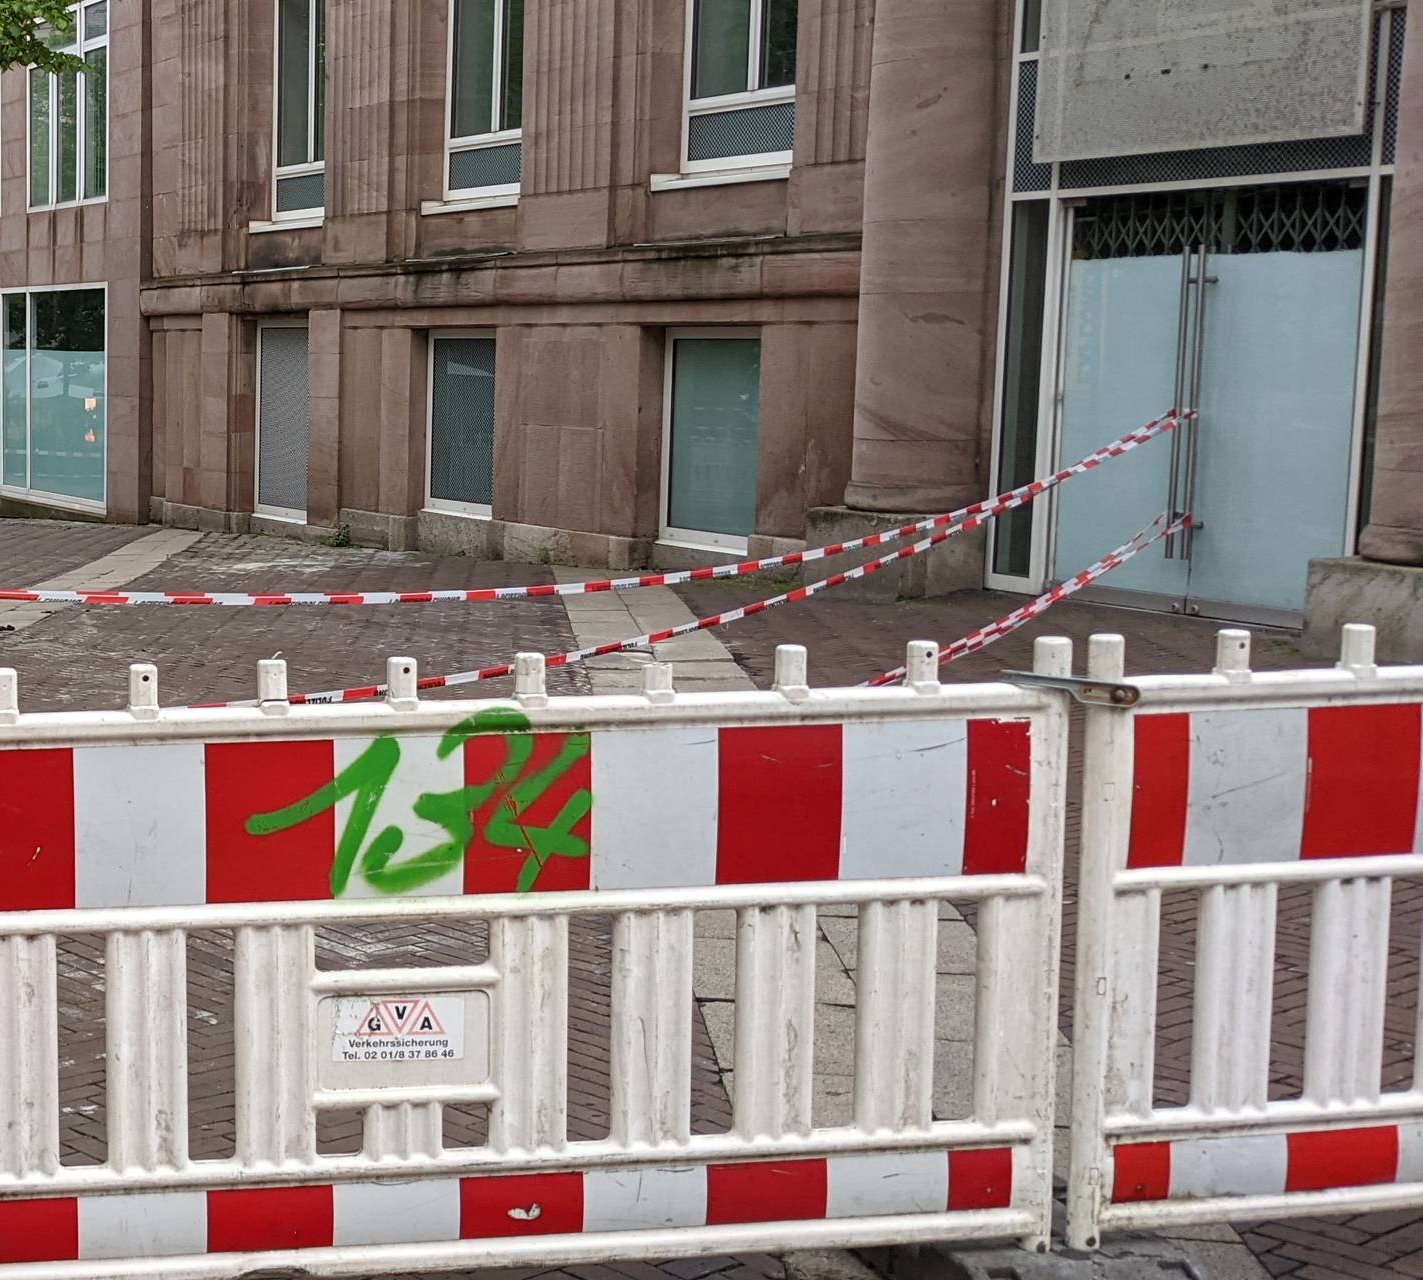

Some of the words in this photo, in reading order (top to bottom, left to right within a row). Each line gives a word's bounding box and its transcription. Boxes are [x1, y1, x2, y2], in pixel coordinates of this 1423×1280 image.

[244, 707, 592, 898] 134
[348, 1039, 449, 1048] Verkehrssicherung
[342, 1051, 361, 1060] Tel.
[364, 1051, 378, 1060] 02
[380, 1050, 405, 1060] 01/8
[408, 1050, 421, 1059] 37
[424, 1049, 438, 1058] 86
[441, 1049, 455, 1058] 46
